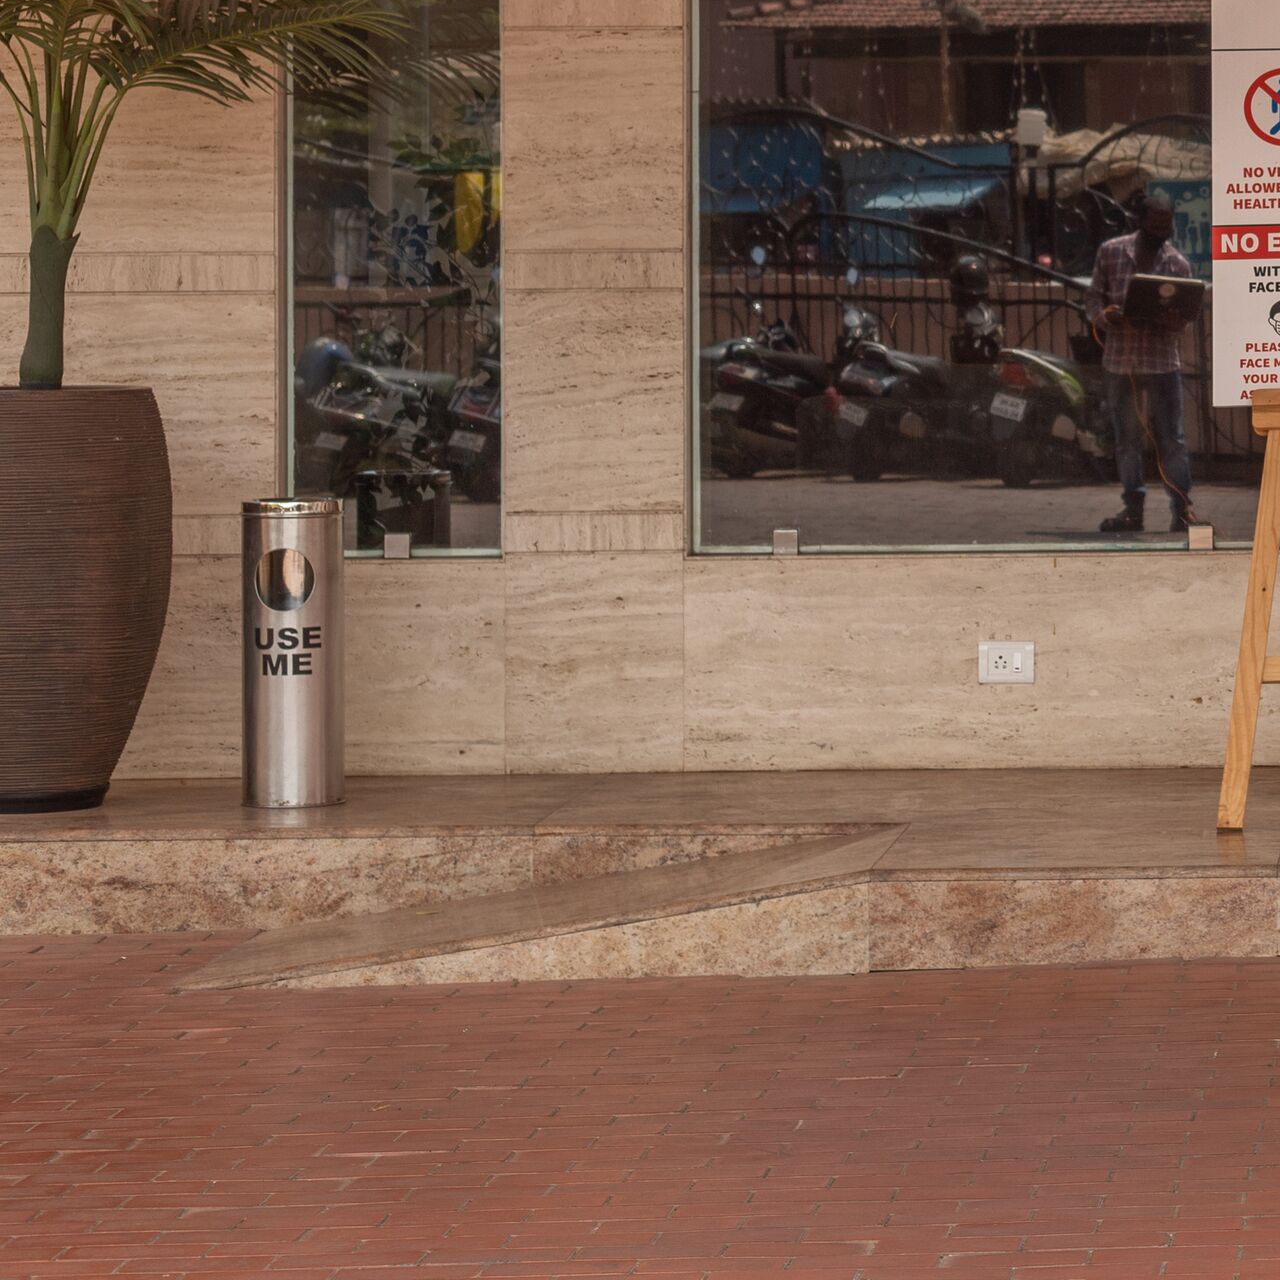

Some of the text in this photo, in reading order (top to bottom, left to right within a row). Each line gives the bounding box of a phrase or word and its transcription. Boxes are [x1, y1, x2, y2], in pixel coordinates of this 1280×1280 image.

[1242, 166, 1263, 178] NO
[1220, 233, 1262, 254] NO
[1239, 357, 1270, 368] FACE
[1242, 373, 1277, 384] YOUR
[254, 626, 322, 650] USE
[262, 653, 313, 676] ME
